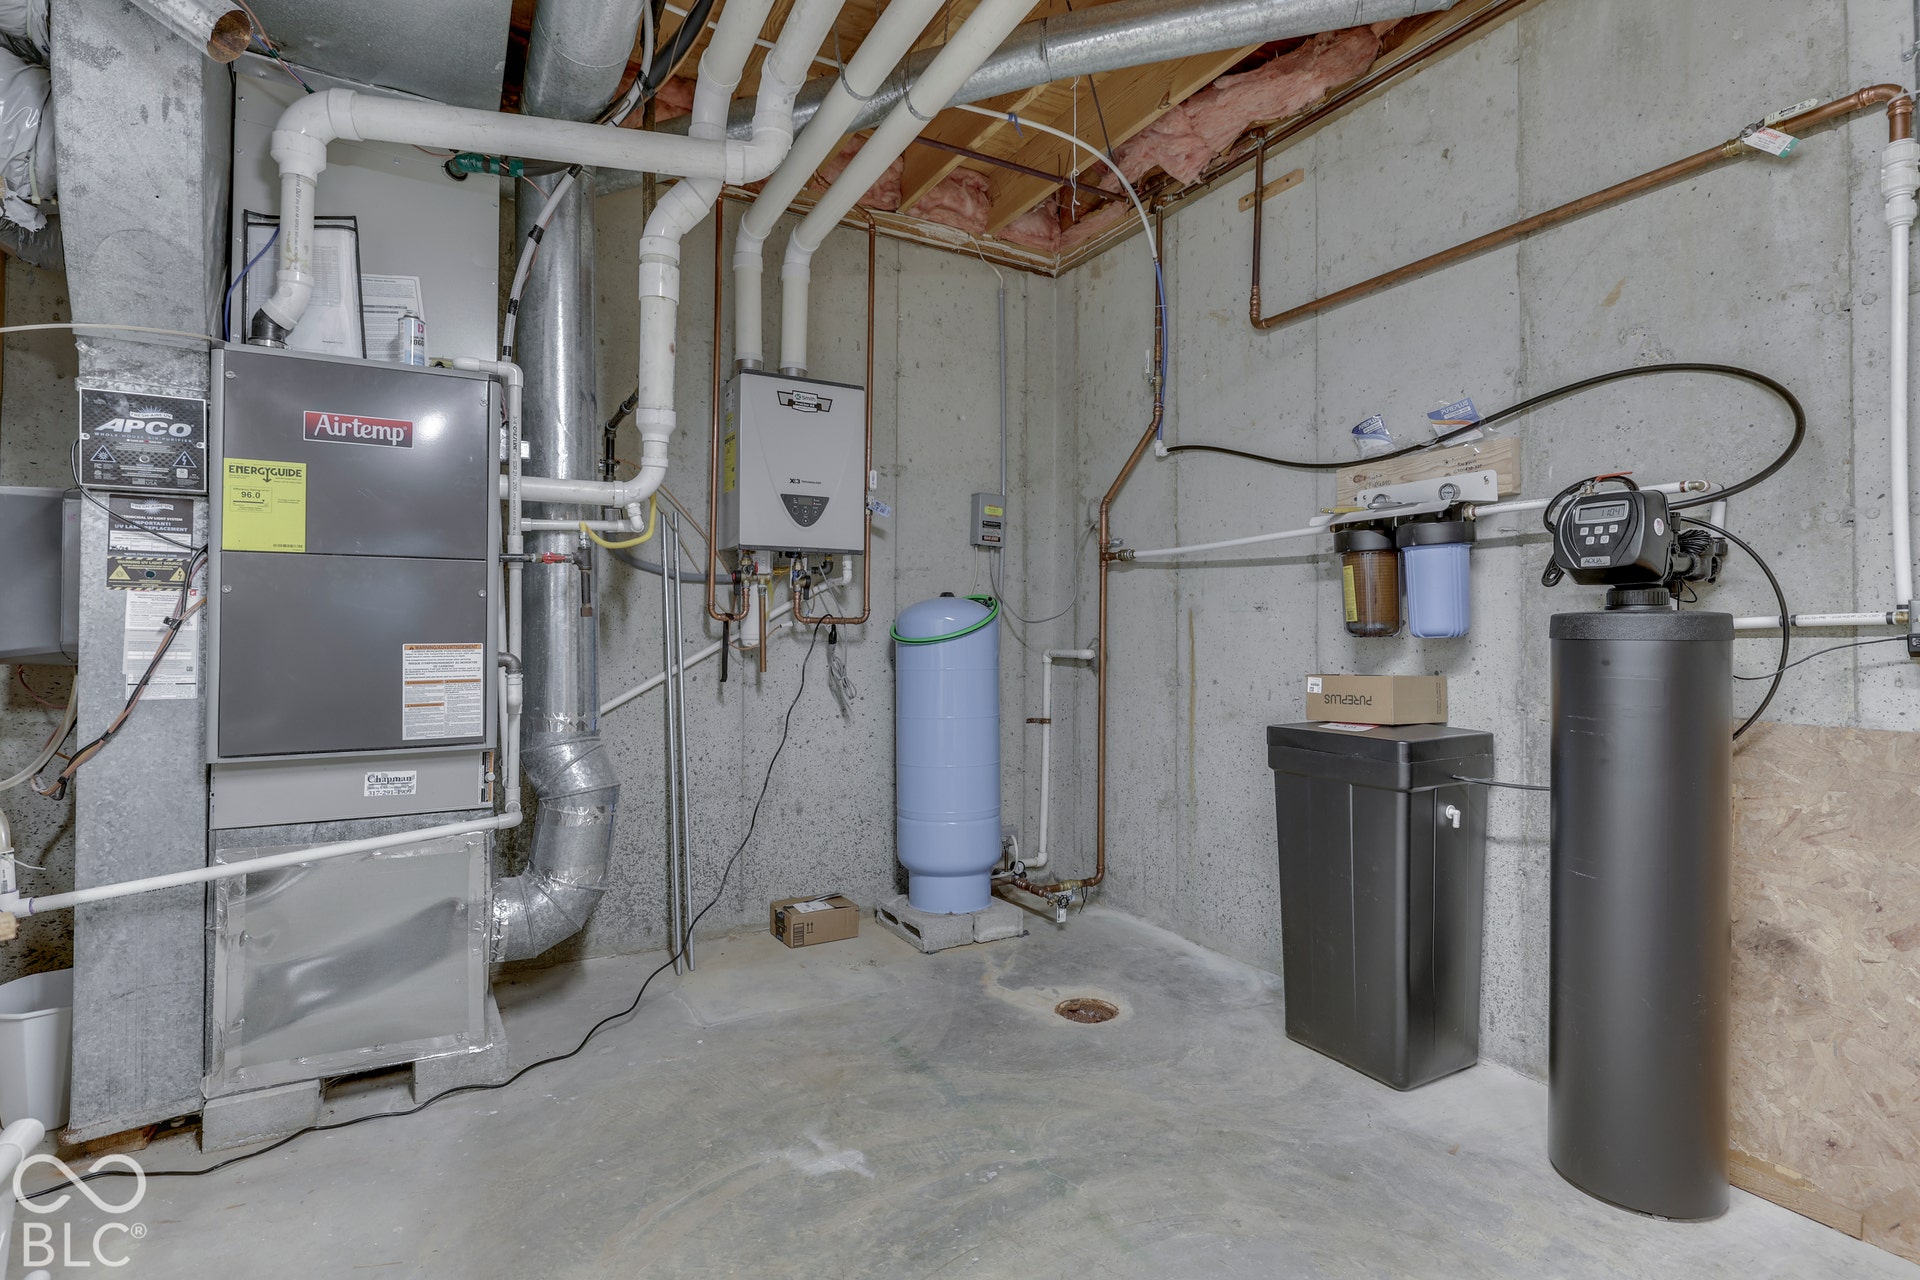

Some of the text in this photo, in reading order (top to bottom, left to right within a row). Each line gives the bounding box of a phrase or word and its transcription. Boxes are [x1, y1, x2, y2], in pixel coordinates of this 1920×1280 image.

[1440, 399, 1469, 415] PUREPLUS
[94, 418, 192, 437] APCO
[314, 414, 405, 446] Airtemp
[228, 465, 303, 479] ENERGYGUIDE
[241, 491, 261, 499] 96.0
[1324, 694, 1372, 706] PUREPLUS
[367, 774, 412, 784] Chapman
